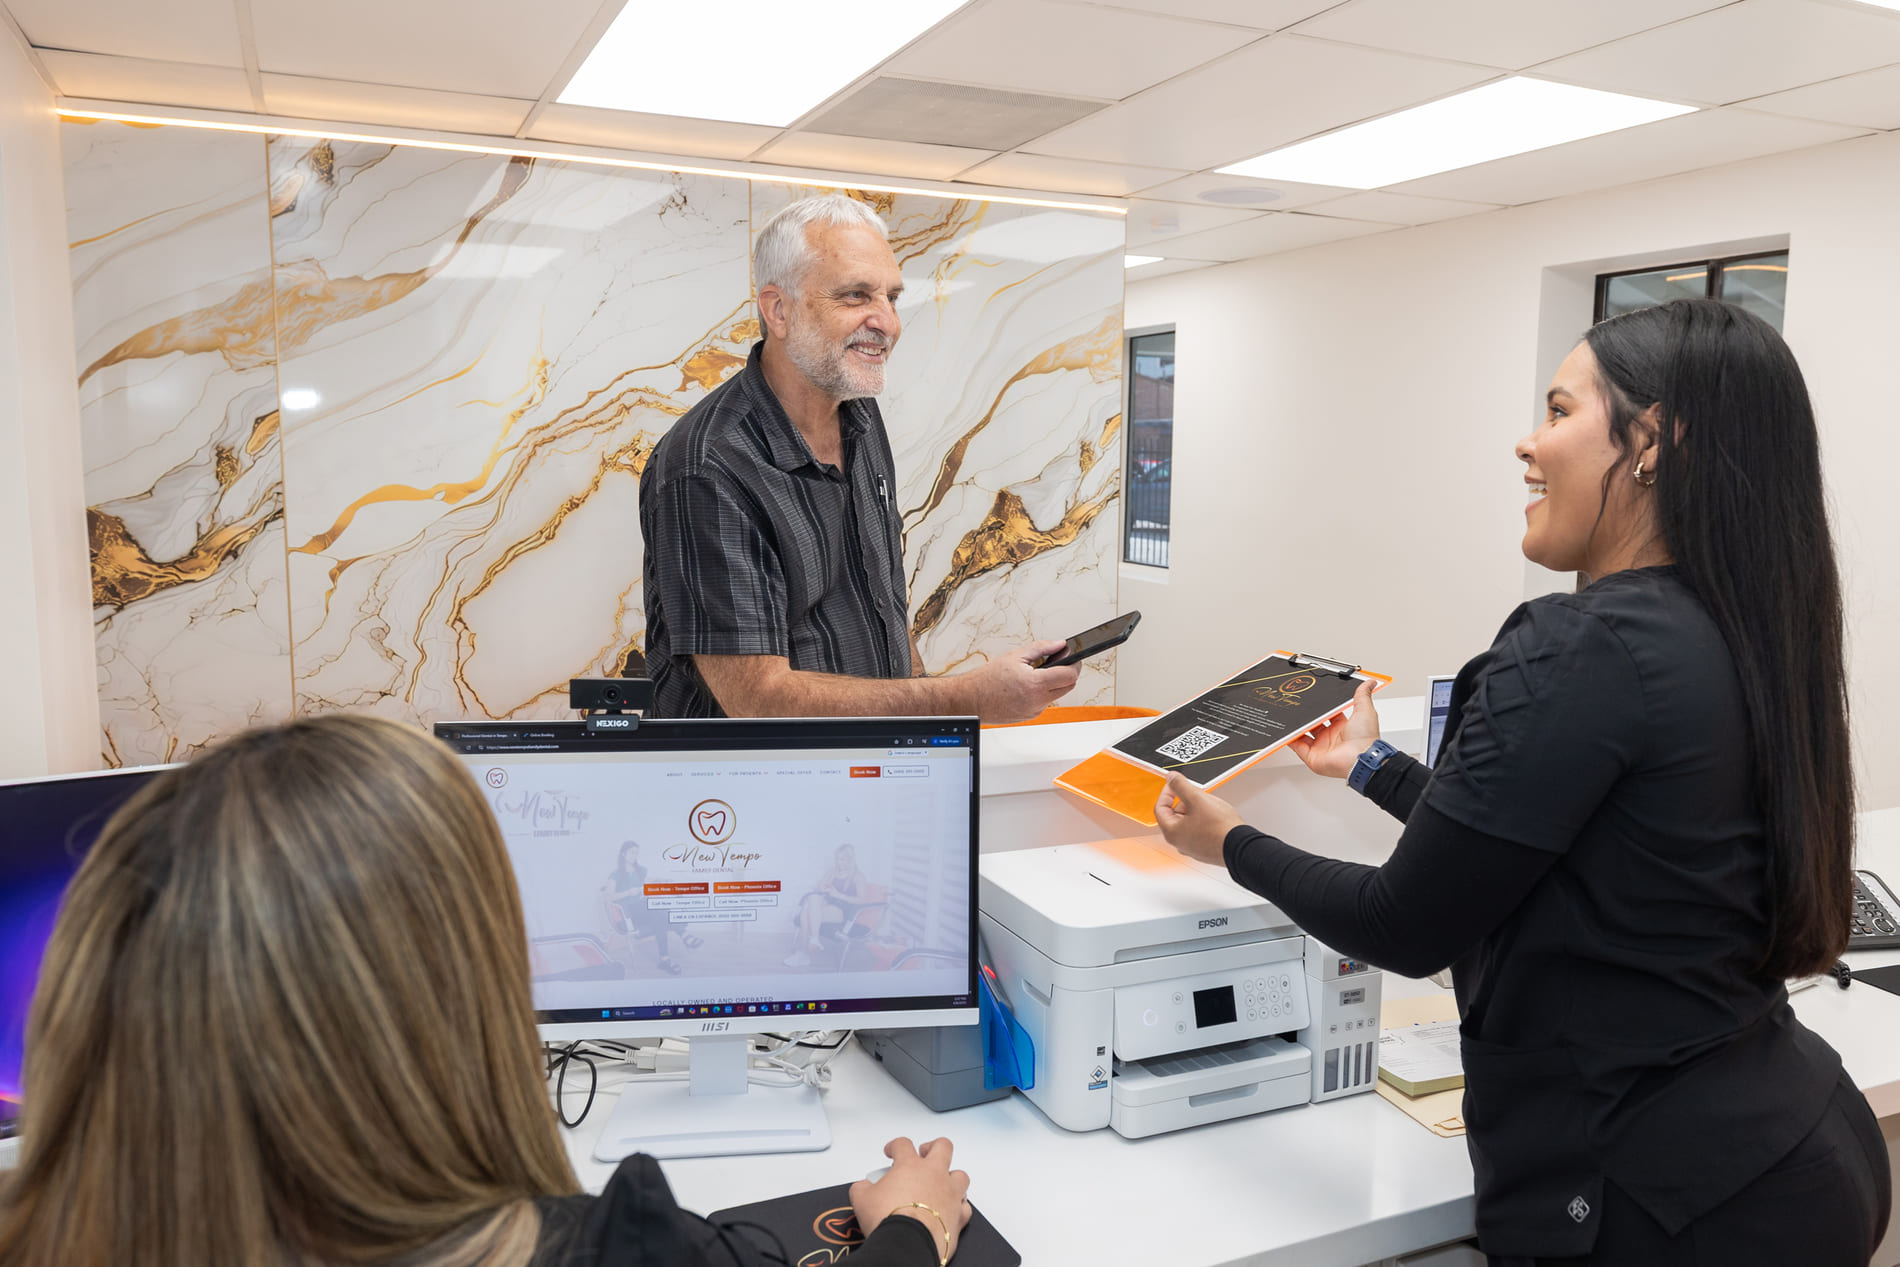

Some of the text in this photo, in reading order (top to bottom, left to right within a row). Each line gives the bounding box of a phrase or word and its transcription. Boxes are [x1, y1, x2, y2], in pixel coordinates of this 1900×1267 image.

[596, 719, 630, 728] NEXIGO
[662, 842, 762, 868] New Tempo
[1198, 916, 1229, 930] EPSON
